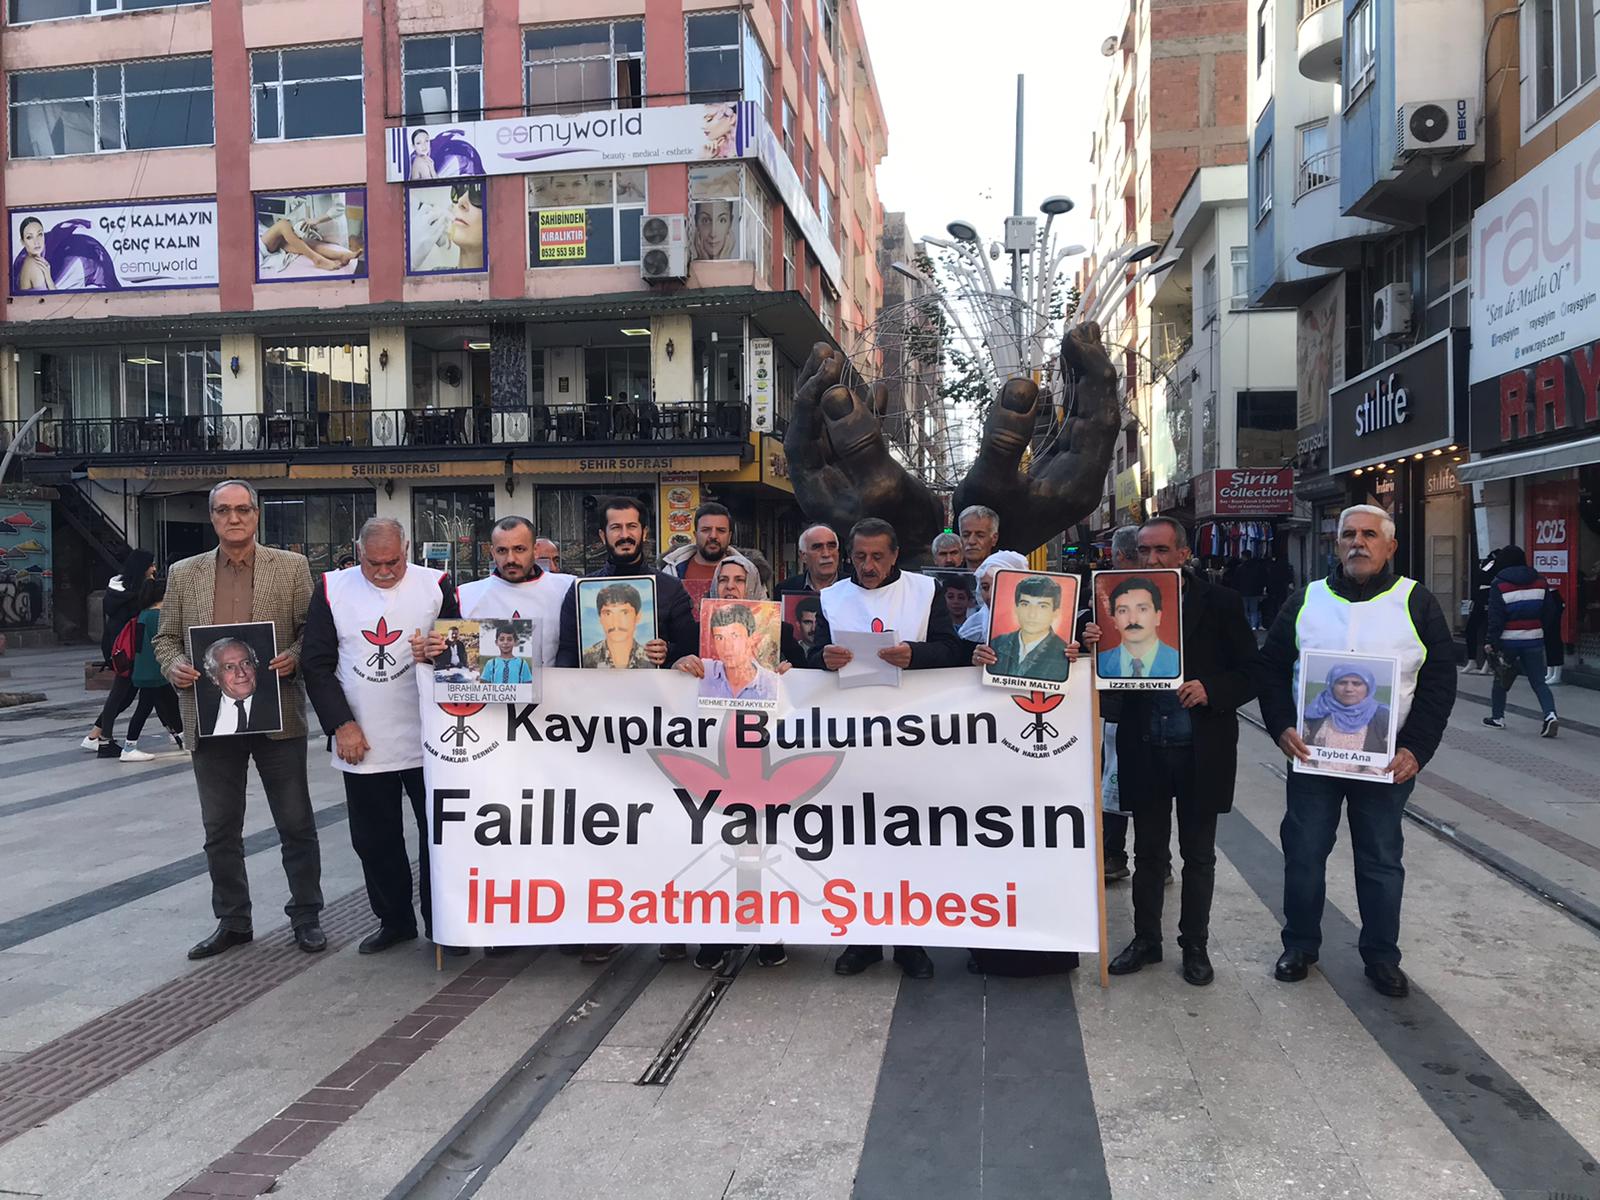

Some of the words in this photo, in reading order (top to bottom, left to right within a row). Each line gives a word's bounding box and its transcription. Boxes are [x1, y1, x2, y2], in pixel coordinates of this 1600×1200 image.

[1457, 99, 1466, 140] BEKO
[496, 113, 642, 146] esmyworld
[602, 150, 626, 161] beauty
[632, 148, 660, 158] medical
[666, 146, 694, 156] esthetic
[131, 211, 212, 228] KALMAYIN
[540, 212, 584, 225] SAHİBİNDEN
[155, 235, 200, 249] KALIN
[120, 257, 198, 275] esmyworld
[1505, 291, 1515, 316] de
[1516, 275, 1547, 311] Mutlu
[1521, 330, 1566, 356] www.rays.com.tr
[1355, 372, 1408, 438] stilife
[180, 464, 228, 476] SOFRASI
[389, 463, 440, 475] SOFRASI
[579, 458, 617, 471] ŞEHİR
[619, 458, 672, 469] SOFRASI
[1230, 471, 1279, 488] Şirin
[1427, 467, 1456, 492] stilife
[1219, 487, 1288, 497] Collection
[1535, 520, 1566, 544] 2023
[1535, 555, 1559, 570] rays
[447, 683, 481, 692] İBRAHİM
[482, 684, 517, 692] ATILGAN
[992, 677, 1027, 687] M.ŞİRİN
[1029, 681, 1060, 690] MALTU
[1139, 681, 1171, 689] SEVEN
[448, 693, 480, 701] VEYSEL
[481, 693, 517, 702] ATILGAN
[729, 699, 745, 707] ZEKİ
[506, 703, 717, 754] Kayıplar
[736, 706, 997, 750] Bulunsun
[440, 755, 469, 763] HAKLARI
[472, 740, 500, 761] DERNEĞİ
[1022, 751, 1050, 759] HAKLARI
[1053, 735, 1078, 756] DERNEĞİ
[1316, 748, 1349, 760] Taybet
[1351, 753, 1371, 762] Ana
[433, 788, 654, 847] Failler
[674, 788, 1086, 862] Yargılansın
[467, 867, 565, 925] İHD
[588, 880, 800, 925] Batman
[822, 878, 1018, 937] Şubesi
